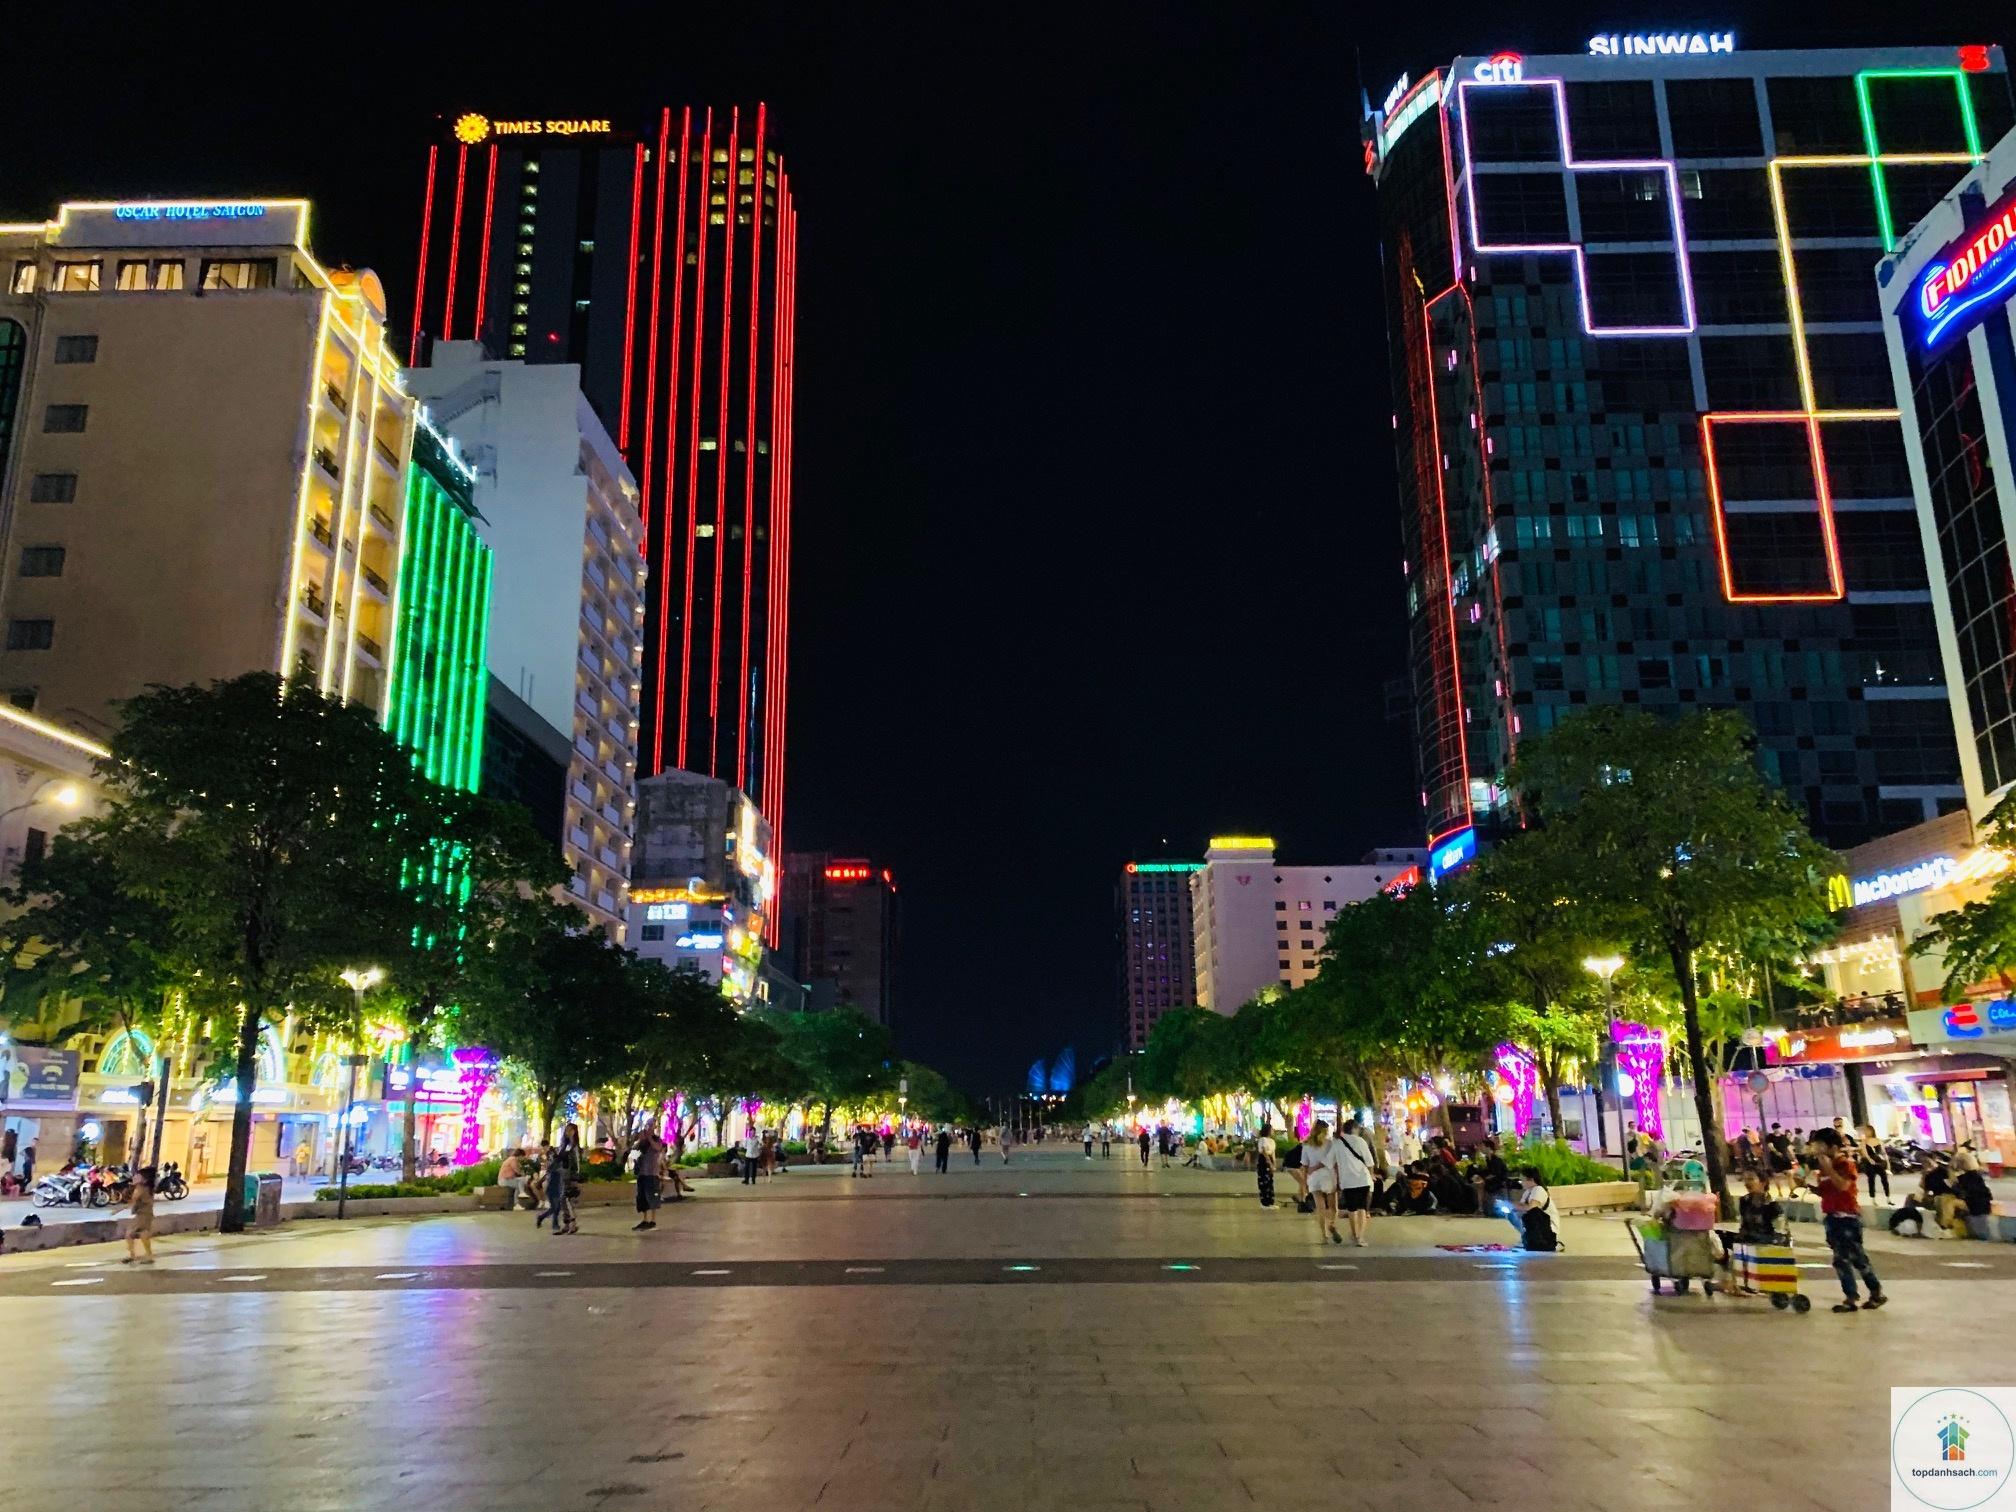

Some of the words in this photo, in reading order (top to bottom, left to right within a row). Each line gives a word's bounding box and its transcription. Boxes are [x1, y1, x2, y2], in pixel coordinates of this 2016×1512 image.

[1588, 33, 1734, 56] SUNWAH
[493, 120, 542, 135] TIMES
[545, 119, 611, 135] SQUARE
[116, 205, 159, 218] OSCAR
[165, 205, 209, 218] HOTEL
[213, 204, 264, 216] SAIGON
[1854, 857, 1961, 906] McDonald's
